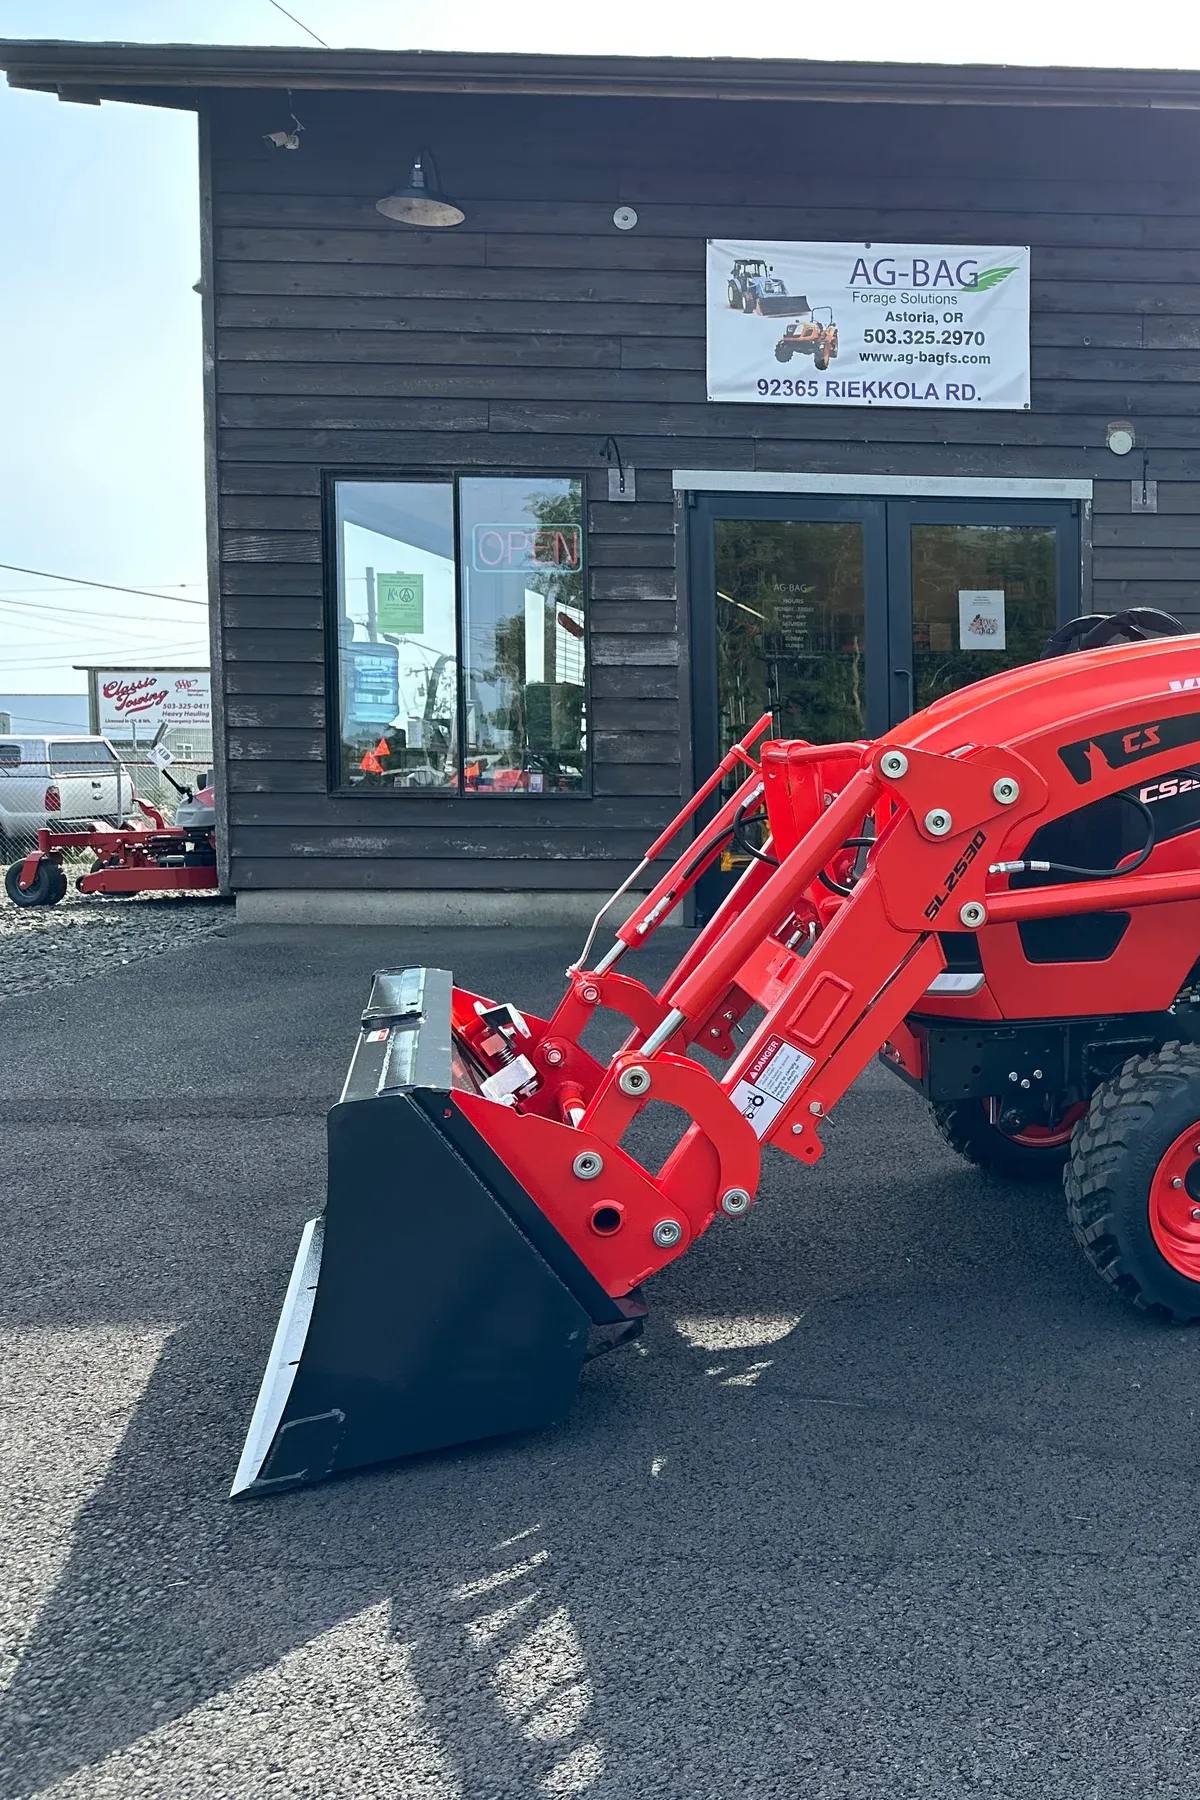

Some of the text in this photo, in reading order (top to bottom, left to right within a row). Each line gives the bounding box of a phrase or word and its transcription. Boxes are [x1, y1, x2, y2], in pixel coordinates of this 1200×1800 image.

[849, 258, 978, 288] AG-BAG
[852, 291, 958, 306] Forage Solutions
[885, 311, 964, 325] Astoria, OR
[864, 329, 985, 346] 503.325.2970
[859, 352, 990, 366] www.ag-bagfs.com
[757, 378, 982, 402] 92365 RIEKKOLA RD.
[478, 530, 578, 568] OPEN
[774, 584, 807, 593] AG-BAG
[103, 677, 157, 698] Classic
[115, 690, 169, 712] Towing
[1122, 726, 1160, 754] CS
[924, 830, 986, 922] SL2530
[754, 1040, 779, 1071] DANGER
